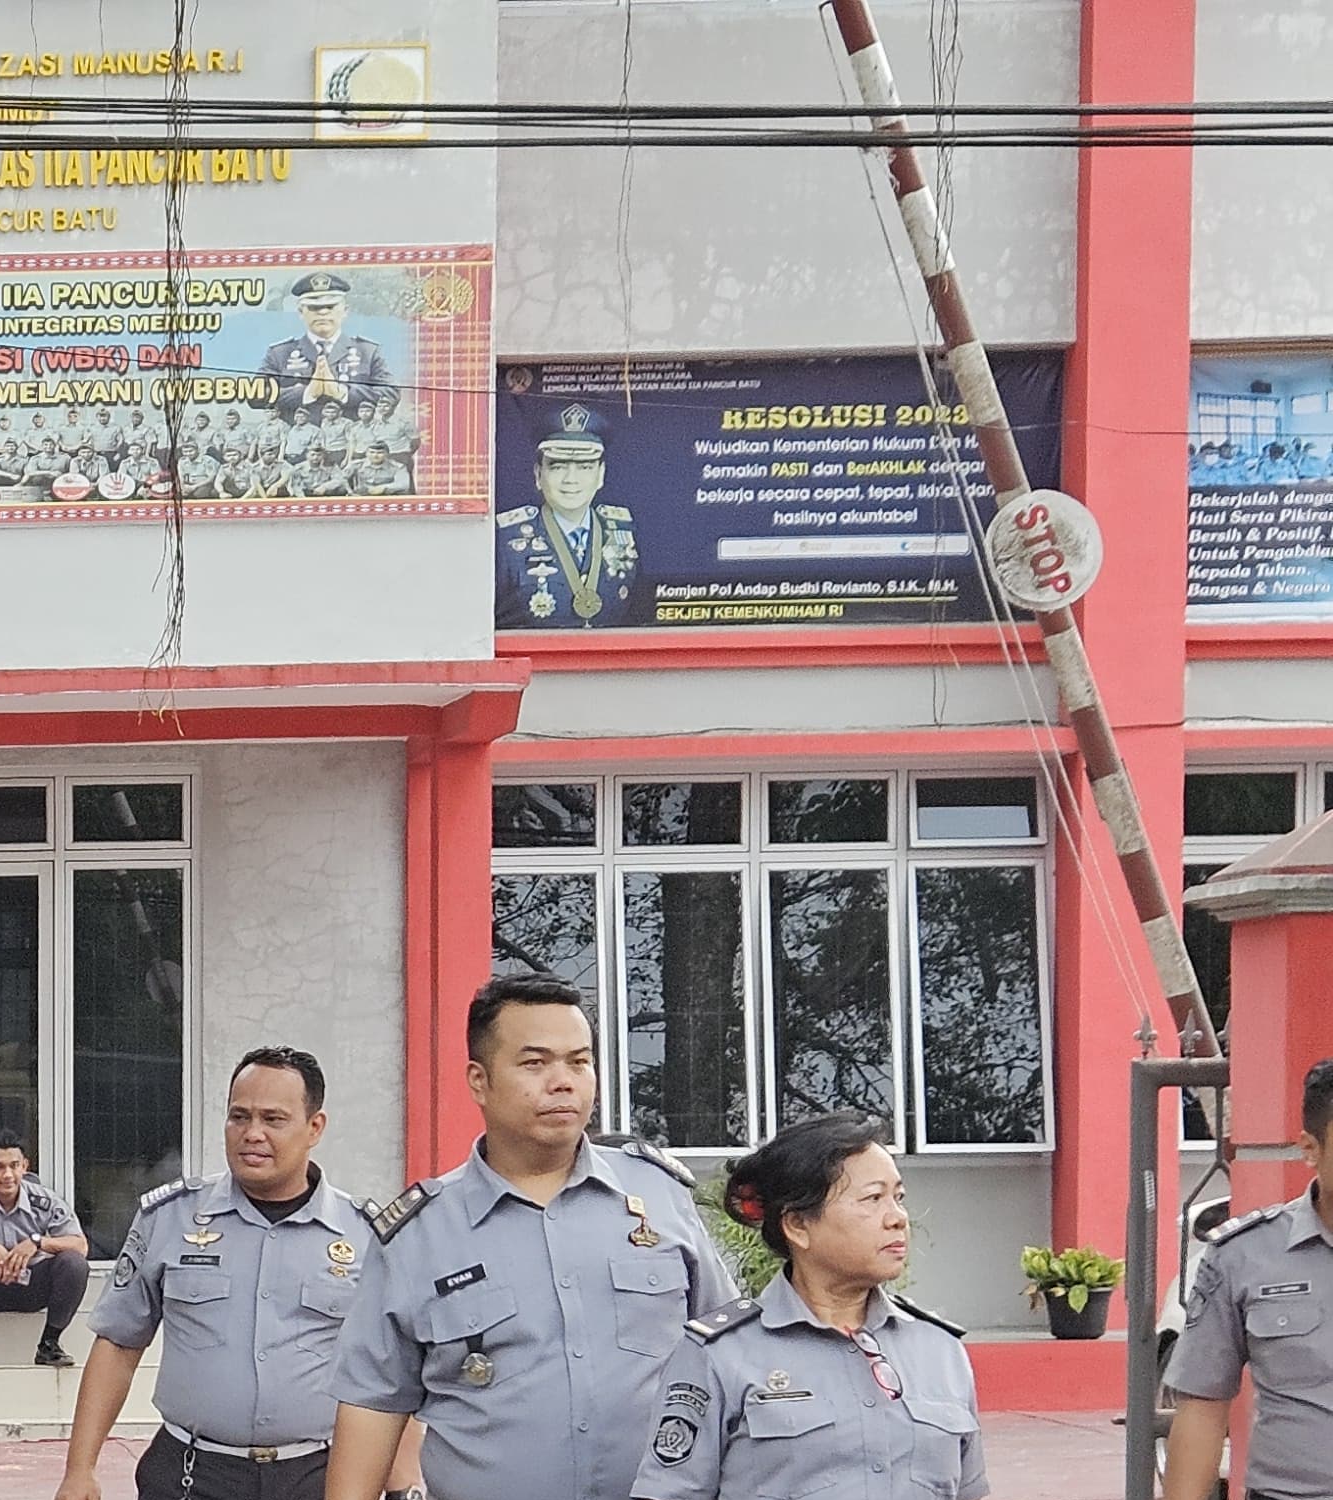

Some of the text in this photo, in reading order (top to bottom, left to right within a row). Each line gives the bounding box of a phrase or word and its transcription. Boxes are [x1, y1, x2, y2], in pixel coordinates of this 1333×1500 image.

[44, 150, 83, 187] IIA
[212, 149, 293, 184] BATU
[52, 207, 118, 232] BATU
[2, 283, 44, 309] IIA
[52, 280, 178, 309] PANCUR
[185, 278, 265, 306] BATU
[32, 344, 130, 375] (WBK)
[137, 343, 202, 370] DAN
[150, 377, 281, 406] (WBBM)
[721, 403, 970, 430] RESOLUSI 2023
[694, 439, 770, 458] Wujudkan
[773, 437, 868, 454] Kementerian
[873, 435, 926, 452] Hukum
[702, 461, 767, 479] Semakin
[771, 461, 810, 478] PASTI
[813, 460, 844, 477] dan
[847, 459, 926, 477] BerAKHLAK
[696, 484, 755, 505] bekerja
[757, 485, 811, 502] secara
[813, 484, 865, 504] cepat,
[868, 484, 914, 504] tepat,
[1189, 491, 1279, 510] Bekerjalah
[773, 507, 918, 528] hasilnya akuntabel
[1189, 510, 1227, 526] Hati
[1230, 509, 1275, 526] Serta
[1189, 527, 1243, 545] Bersih
[1245, 527, 1262, 542] &
[1014, 504, 1073, 593] STOP
[1188, 546, 1240, 562] Untuk
[1187, 564, 1252, 582] Kepada
[656, 583, 706, 600] Komjen
[709, 582, 732, 597] Pol
[733, 581, 778, 599] Andap
[780, 580, 820, 596] Budhi
[1187, 579, 1332, 599] Bangsa & Negara
[656, 603, 845, 621] SEKJEN KEMENKUMHAM RI
[446, 1270, 474, 1288] EVAN
